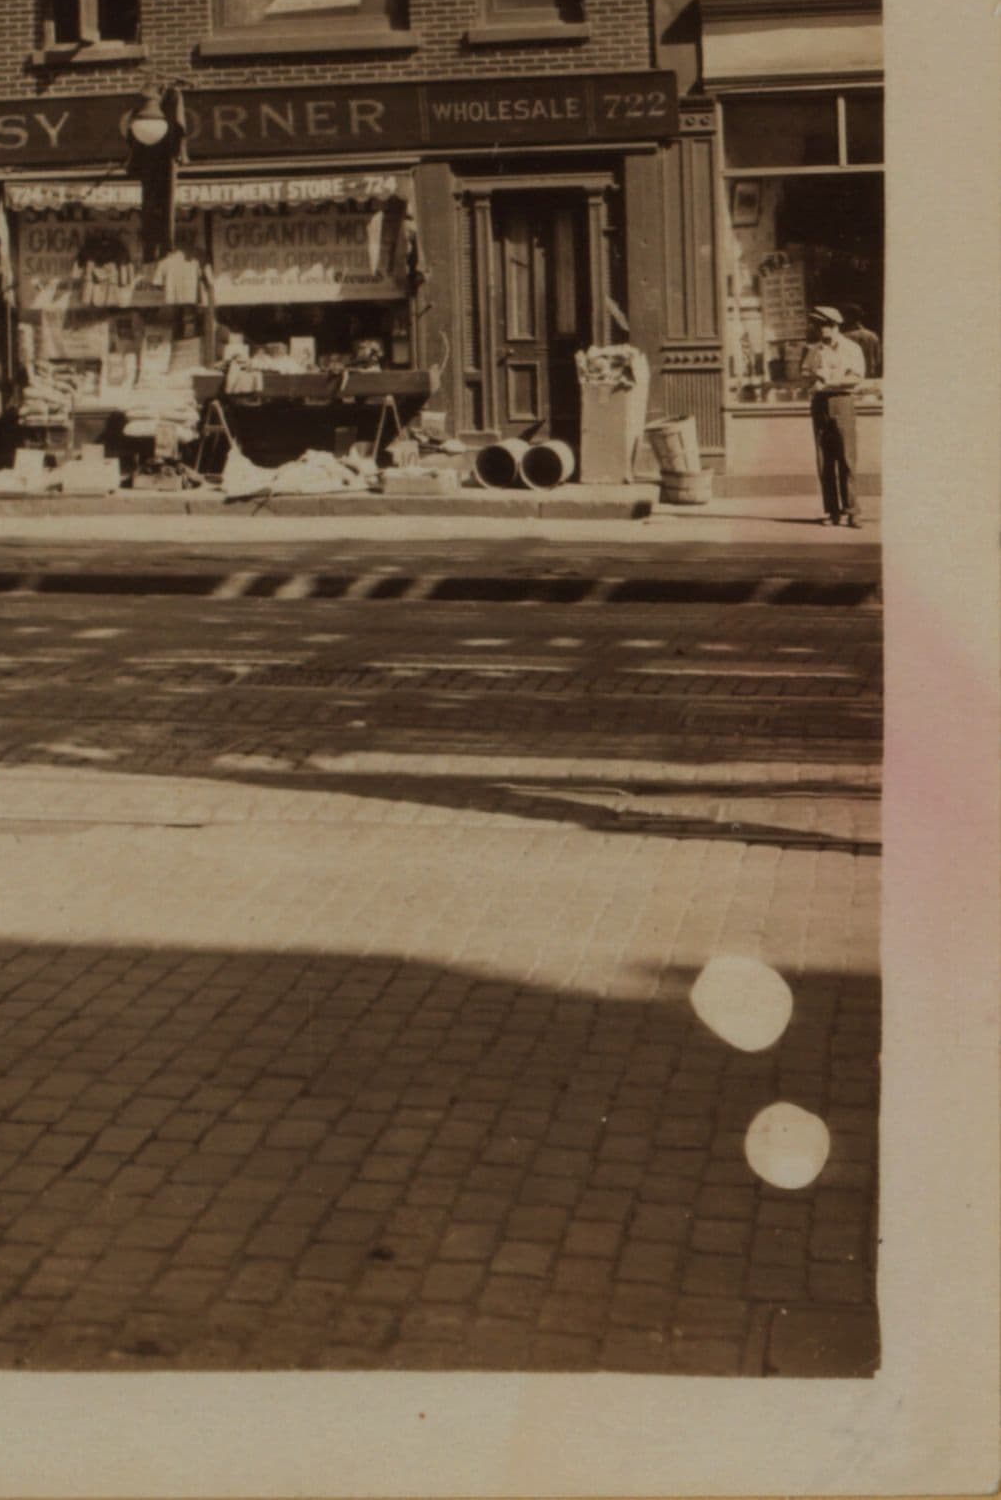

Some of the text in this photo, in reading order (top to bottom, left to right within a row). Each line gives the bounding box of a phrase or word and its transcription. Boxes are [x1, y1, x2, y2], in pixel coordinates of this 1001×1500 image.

[432, 97, 582, 122] WHOLESALE
[602, 92, 668, 120] 722
[287, 178, 344, 201] STORE
[364, 175, 397, 195] 724
[226, 220, 327, 248] GIGANTIC
